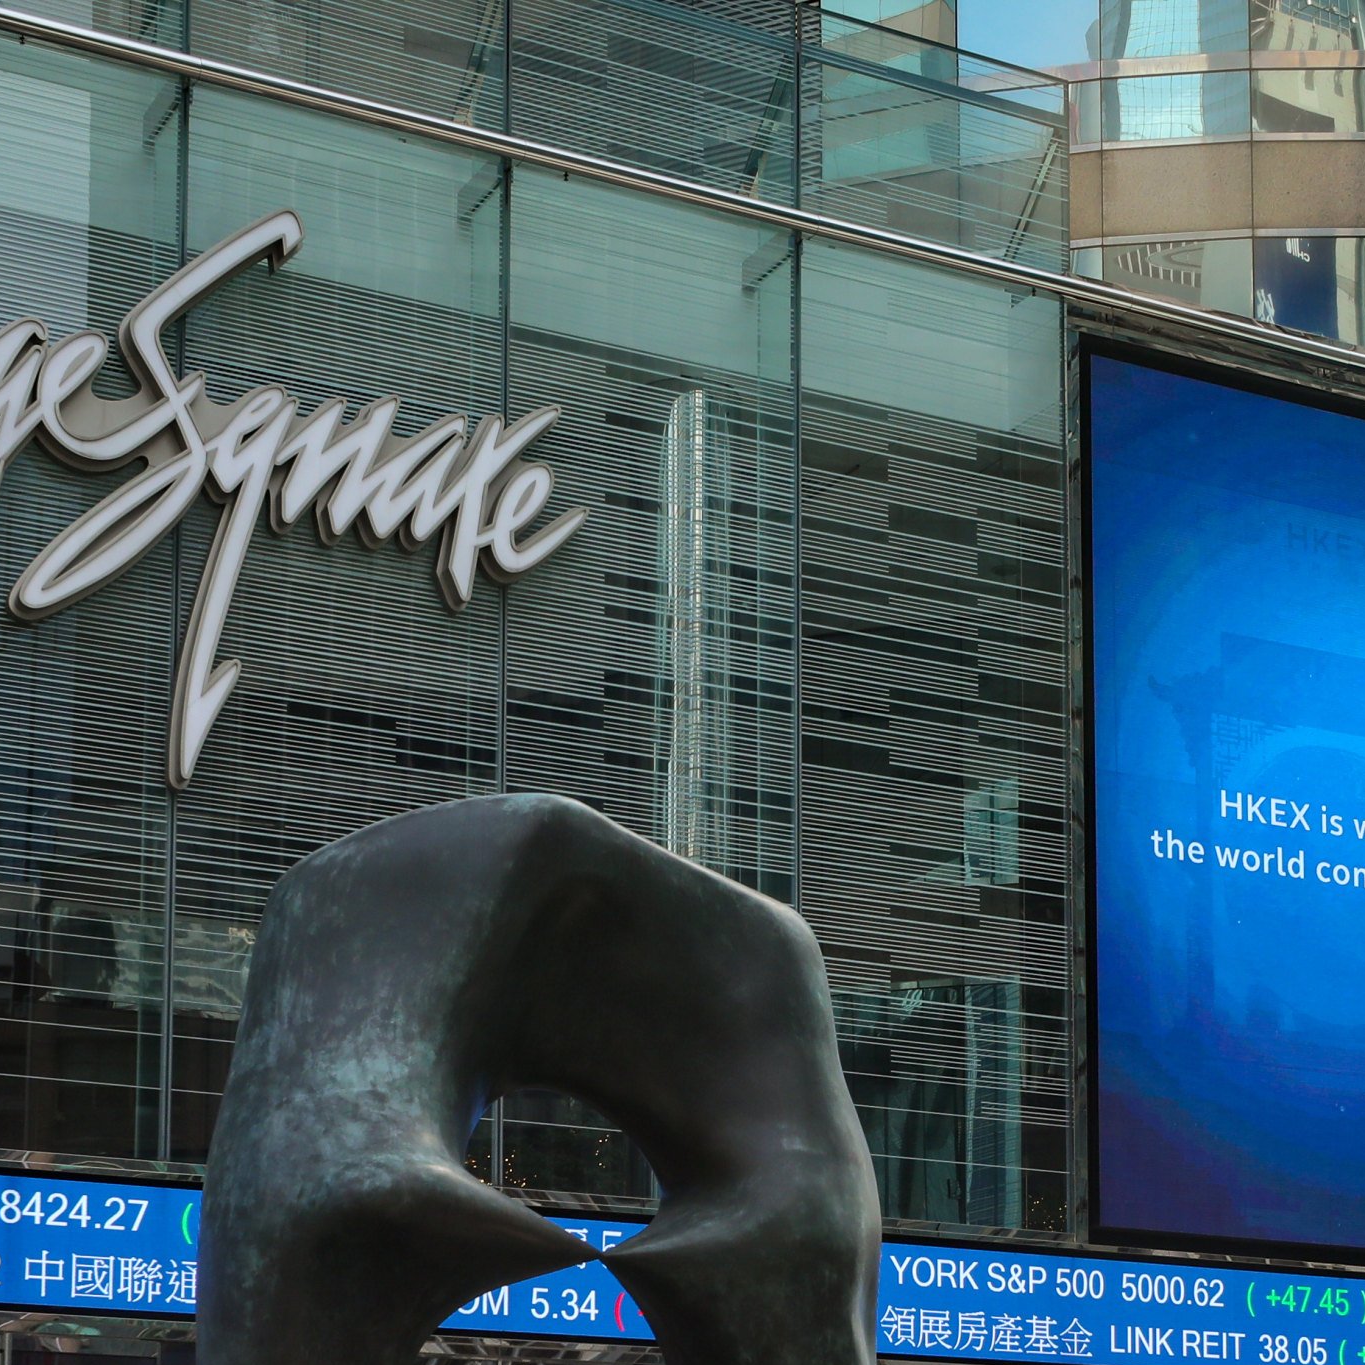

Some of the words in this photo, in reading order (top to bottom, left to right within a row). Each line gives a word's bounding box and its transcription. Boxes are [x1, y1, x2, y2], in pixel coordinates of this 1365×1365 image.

[8, 208, 589, 788] Square
[1220, 790, 1311, 830] HKEX
[1321, 805, 1344, 836] is
[1151, 829, 1205, 863] the
[1215, 846, 1305, 879] world
[23, 1254, 197, 1305] 中國聯通
[531, 1288, 598, 1320] 5.34
[890, 1256, 978, 1289] YORK
[987, 1263, 1046, 1293] S&P
[1056, 1269, 1104, 1298] 500
[1122, 1273, 1223, 1306] 5000.62
[881, 1305, 1092, 1356] 領展房產基金
[1111, 1325, 1174, 1355] LINK
[1183, 1330, 1245, 1359] REIT
[1259, 1335, 1326, 1365] 38.05
